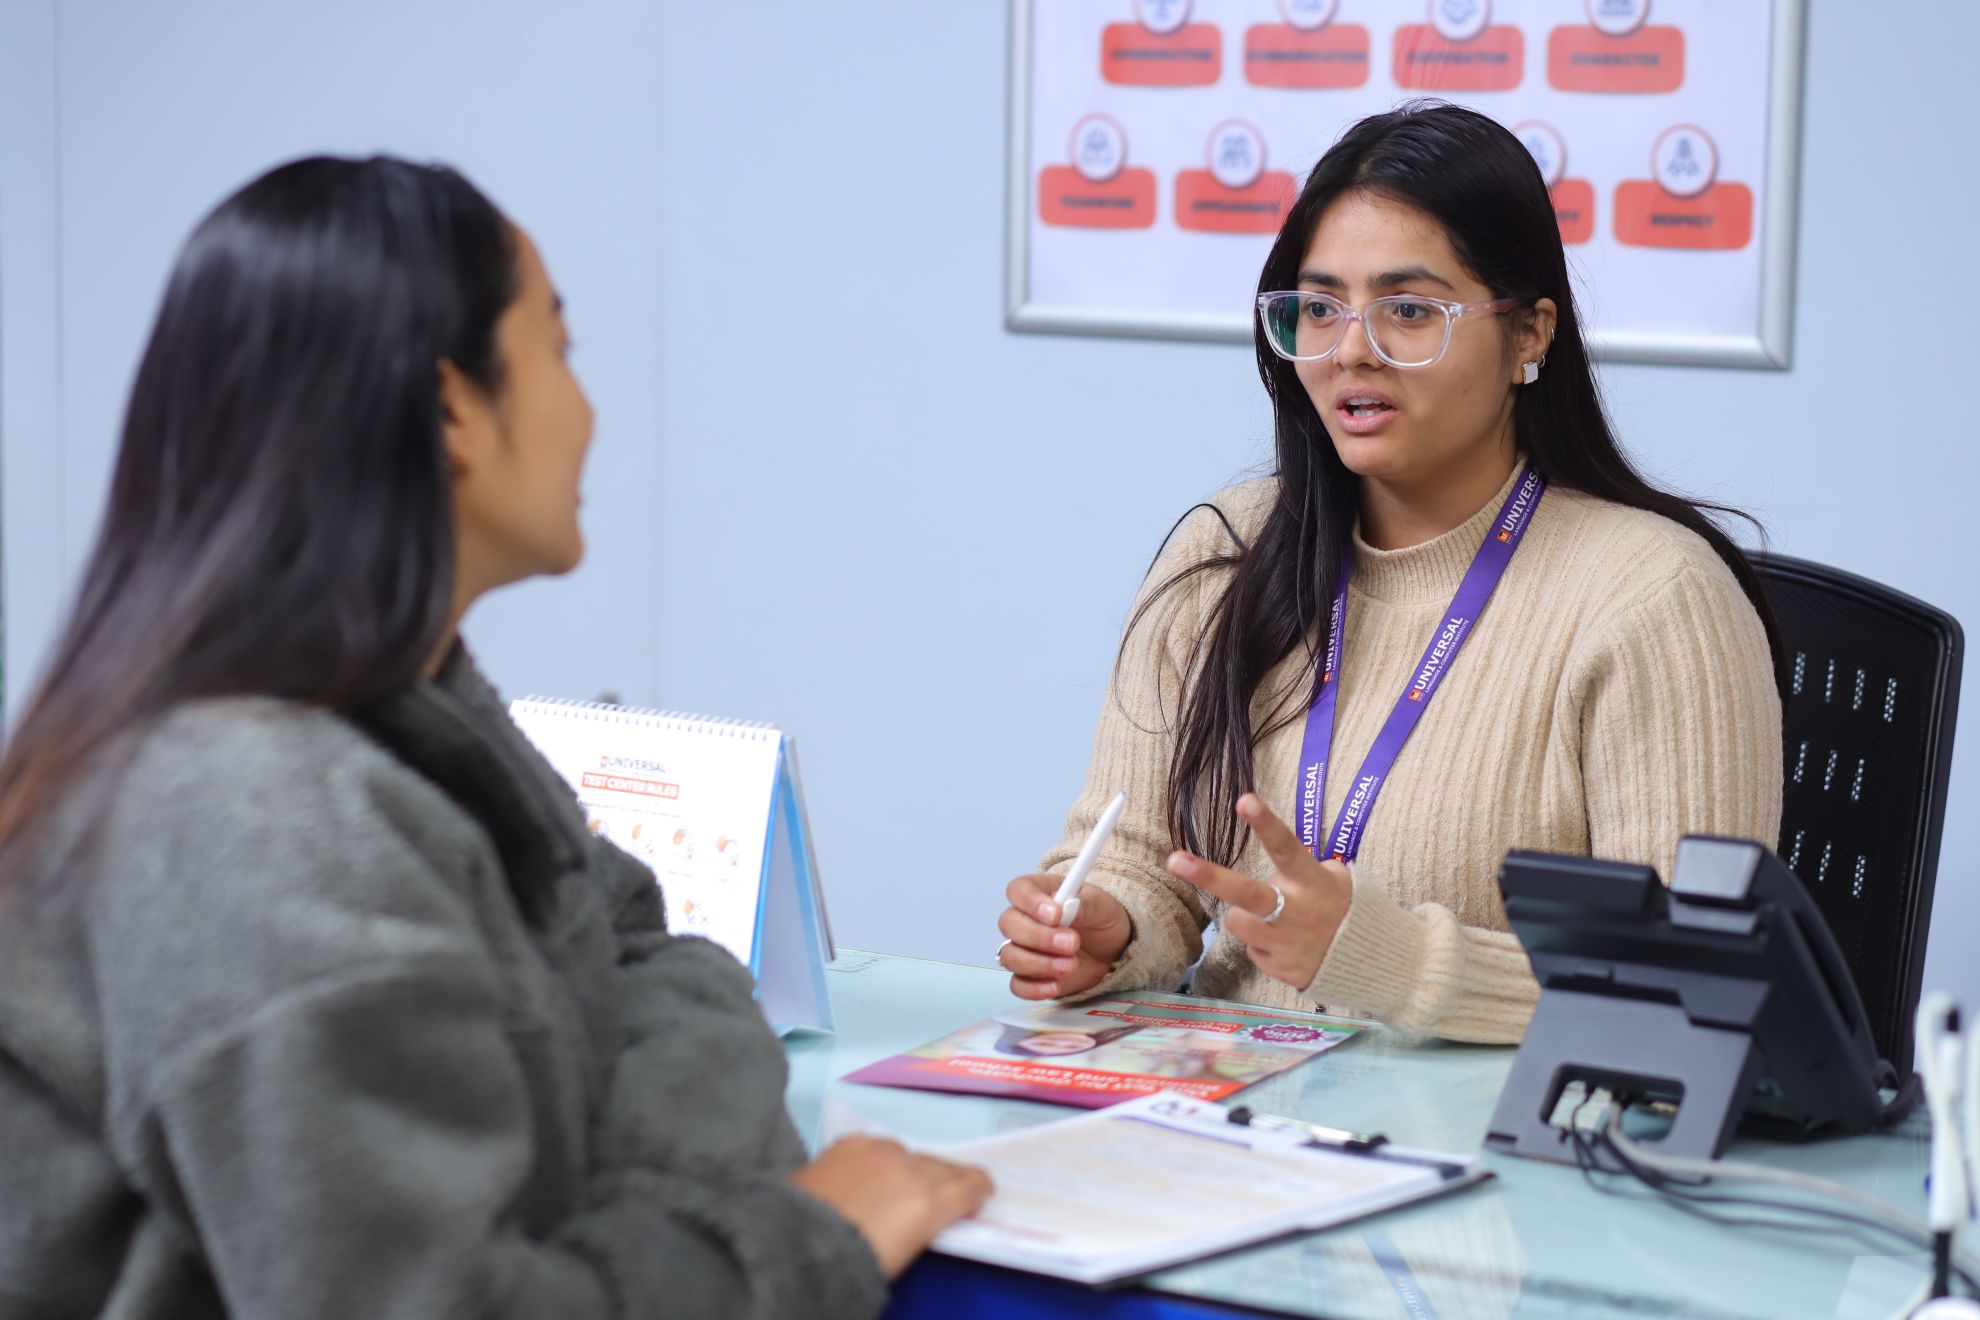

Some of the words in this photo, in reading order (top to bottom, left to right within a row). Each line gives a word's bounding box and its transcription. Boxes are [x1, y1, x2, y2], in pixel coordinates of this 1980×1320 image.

[1414, 616, 1464, 691] UNIVERSAL
[1424, 668, 1442, 693] LANGUAGE
[1440, 641, 1457, 666] COMPUTER
[1453, 618, 1470, 642] INSTITUTE
[608, 757, 666, 774] UNIVERSAL
[1303, 762, 1319, 846] UNIVERSAL
[1333, 775, 1374, 854] UNIVERSAL
[1345, 830, 1358, 858] LANGUAGE
[1355, 800, 1369, 826] COMPUTER
[1365, 776, 1380, 801] INSTITUTE
